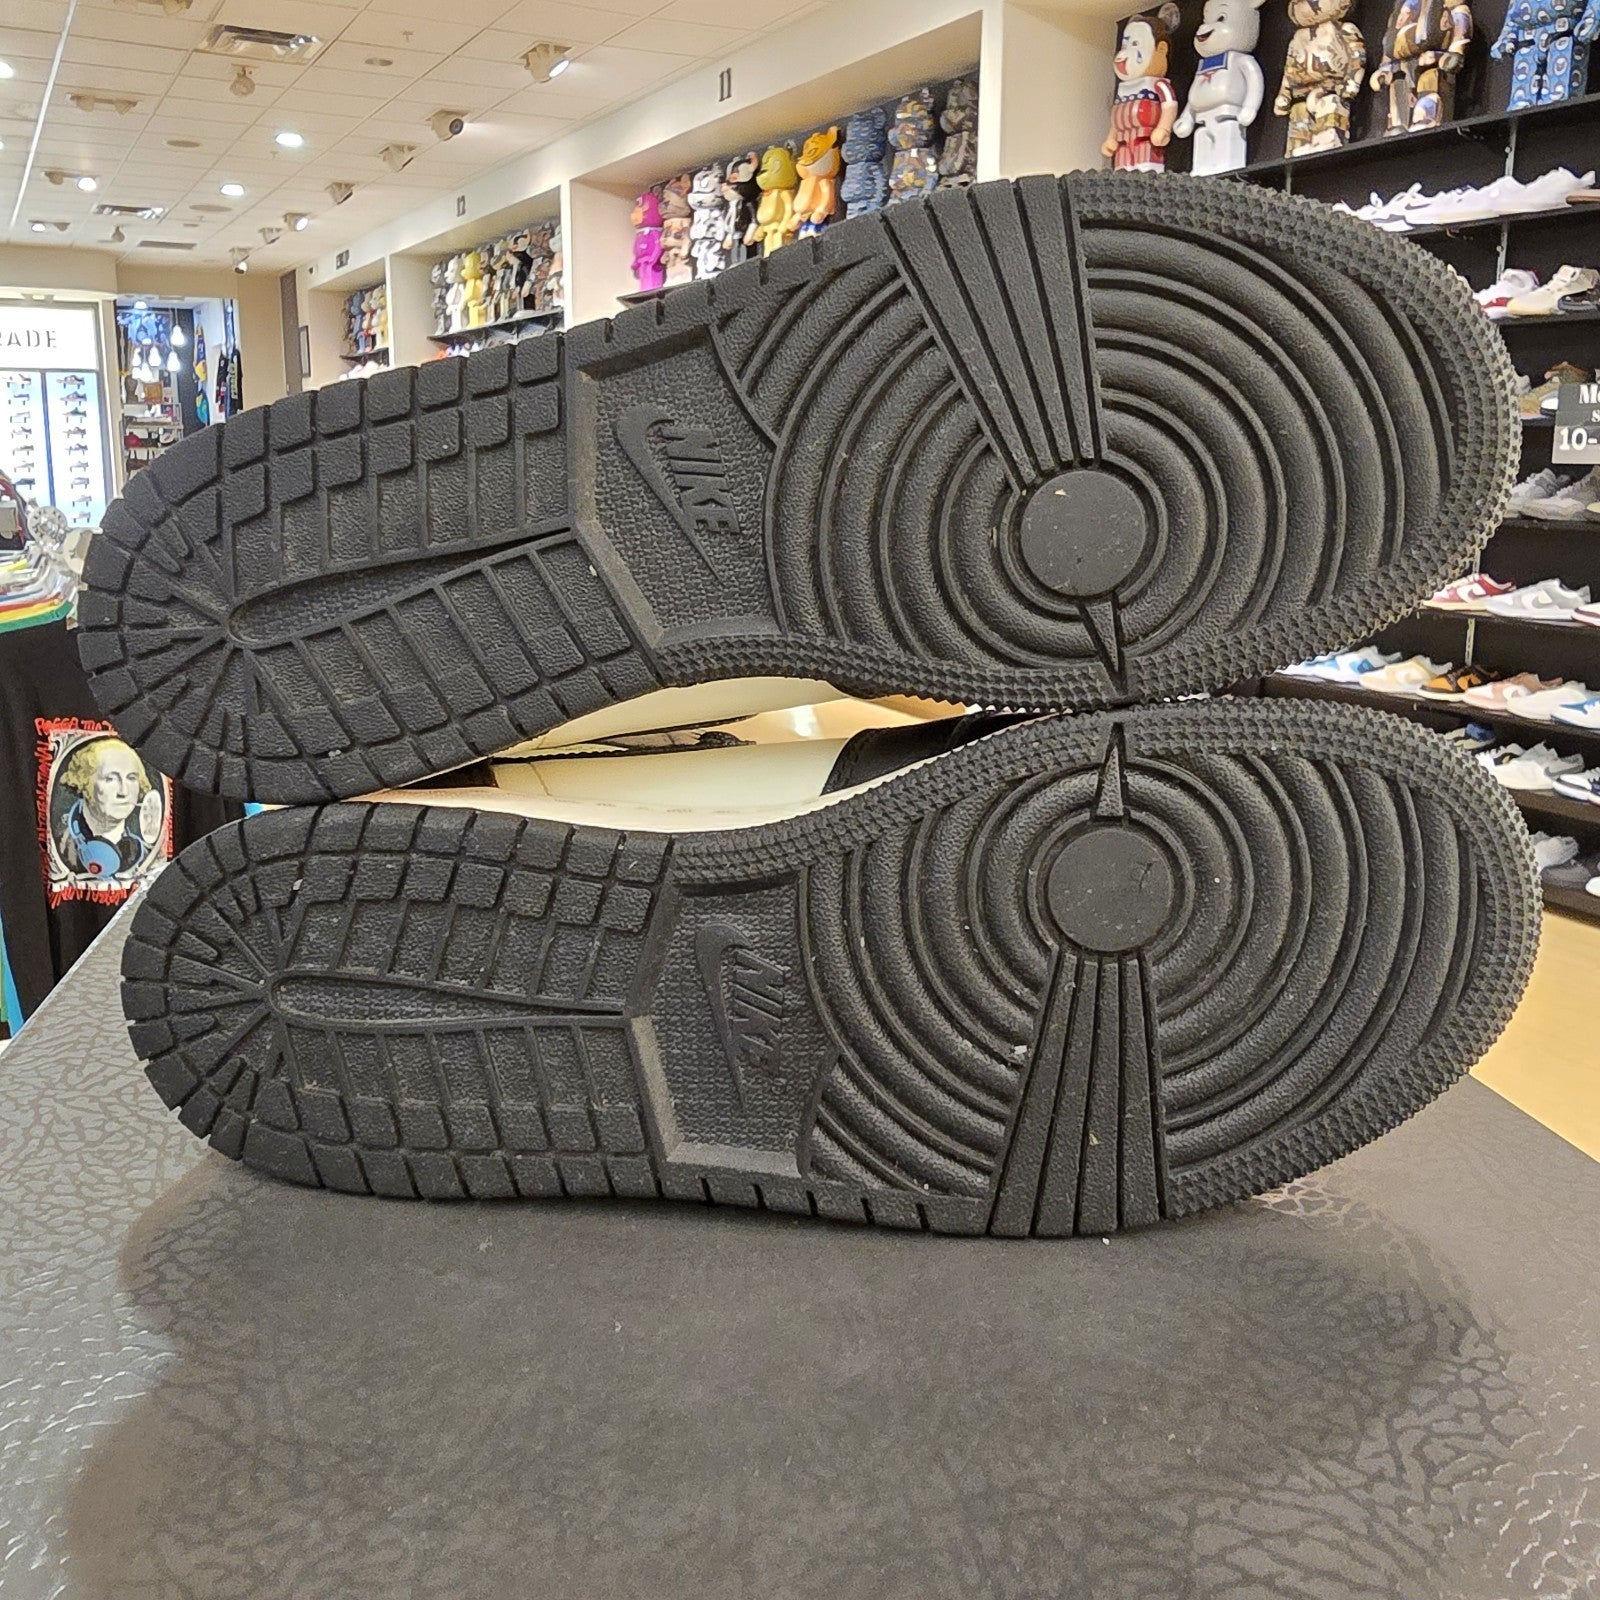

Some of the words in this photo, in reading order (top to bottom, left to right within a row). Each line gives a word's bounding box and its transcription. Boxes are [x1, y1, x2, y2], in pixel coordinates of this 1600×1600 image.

[0, 329, 57, 348] ADE
[1579, 384, 1600, 404] M
[660, 427, 741, 535] NIKE
[729, 948, 785, 1075] NIKE
